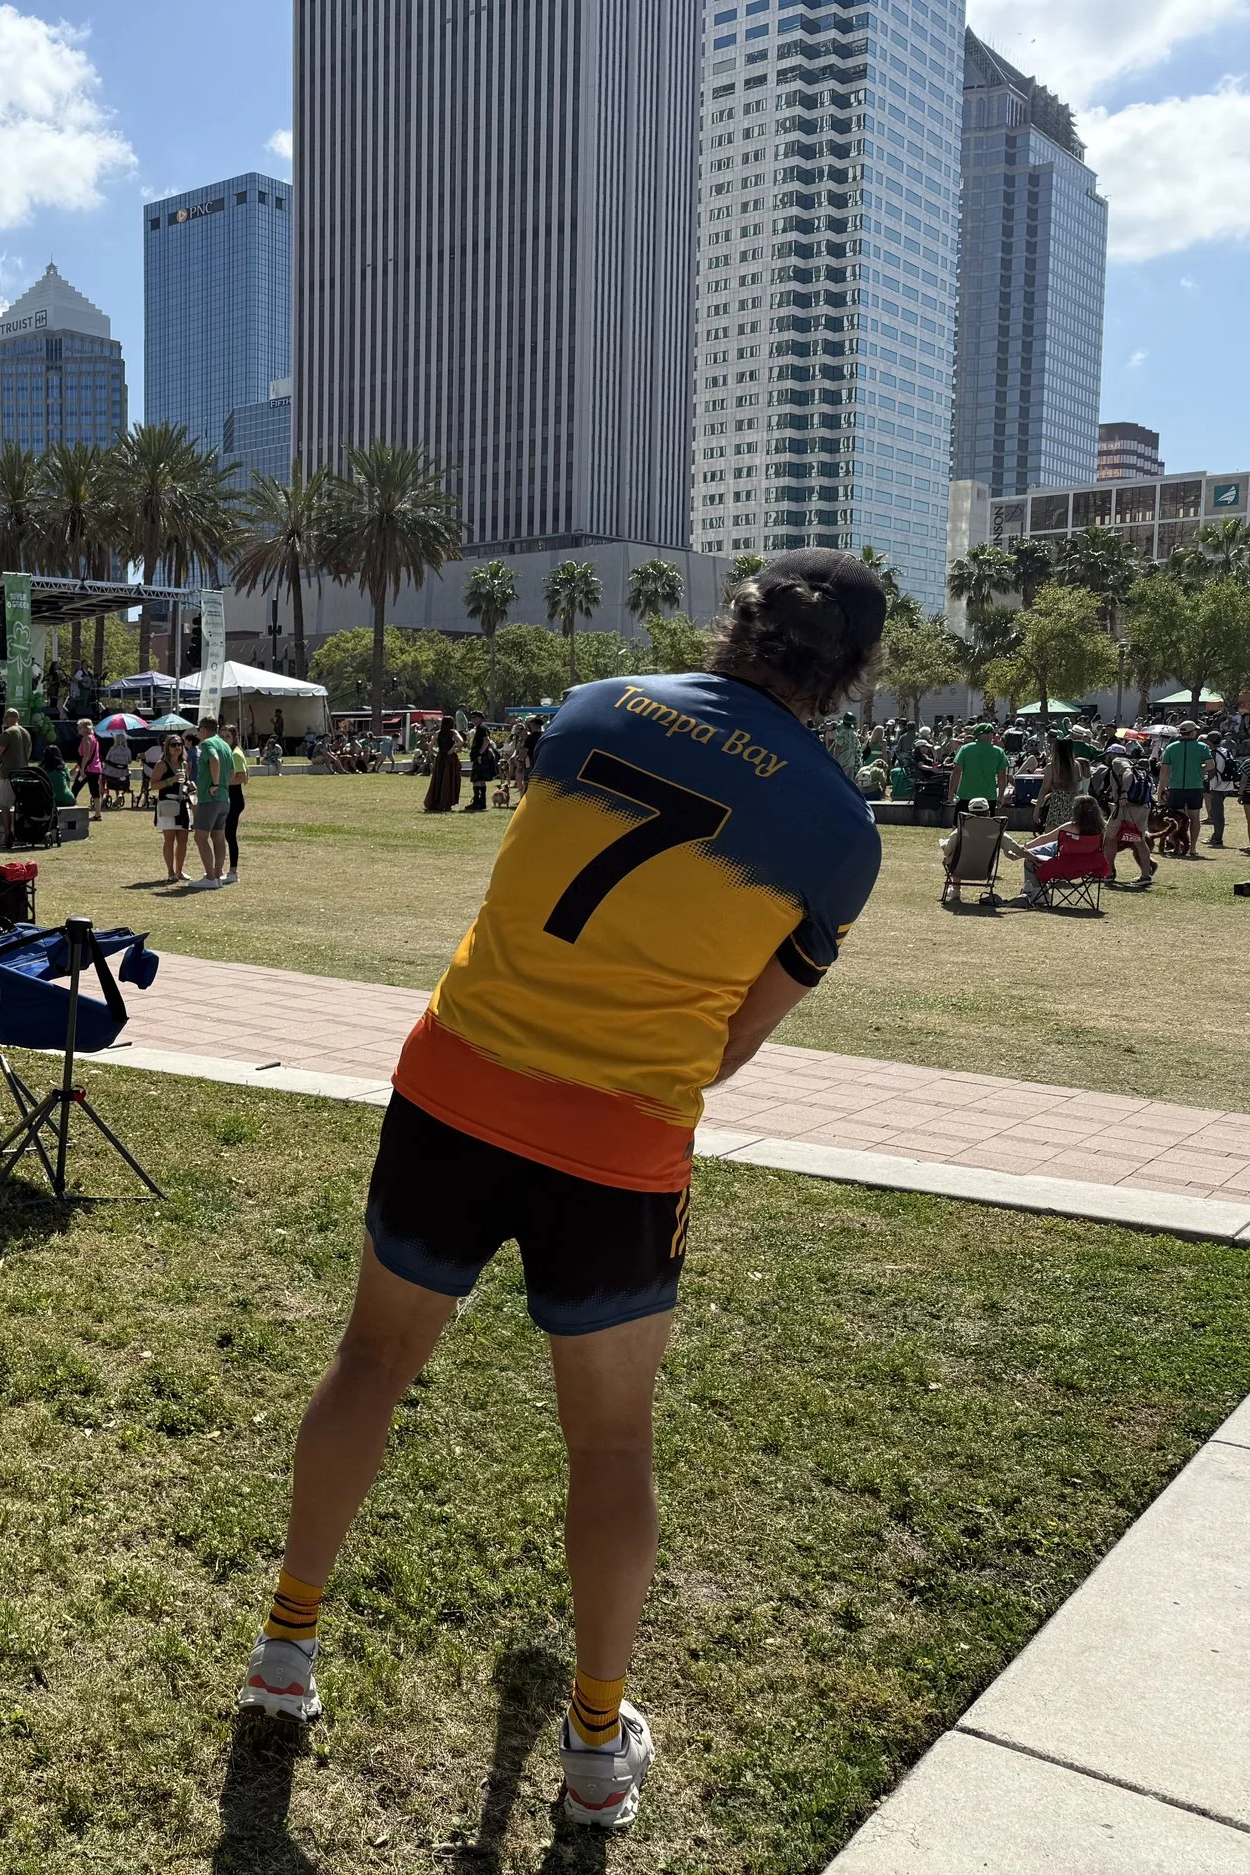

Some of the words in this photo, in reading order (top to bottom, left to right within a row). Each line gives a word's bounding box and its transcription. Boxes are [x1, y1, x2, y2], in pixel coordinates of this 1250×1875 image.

[189, 201, 213, 219] PNC
[0, 316, 33, 335] TRUIST
[614, 685, 718, 745] Tampa
[721, 729, 789, 778] Bay
[543, 749, 733, 945] 7
